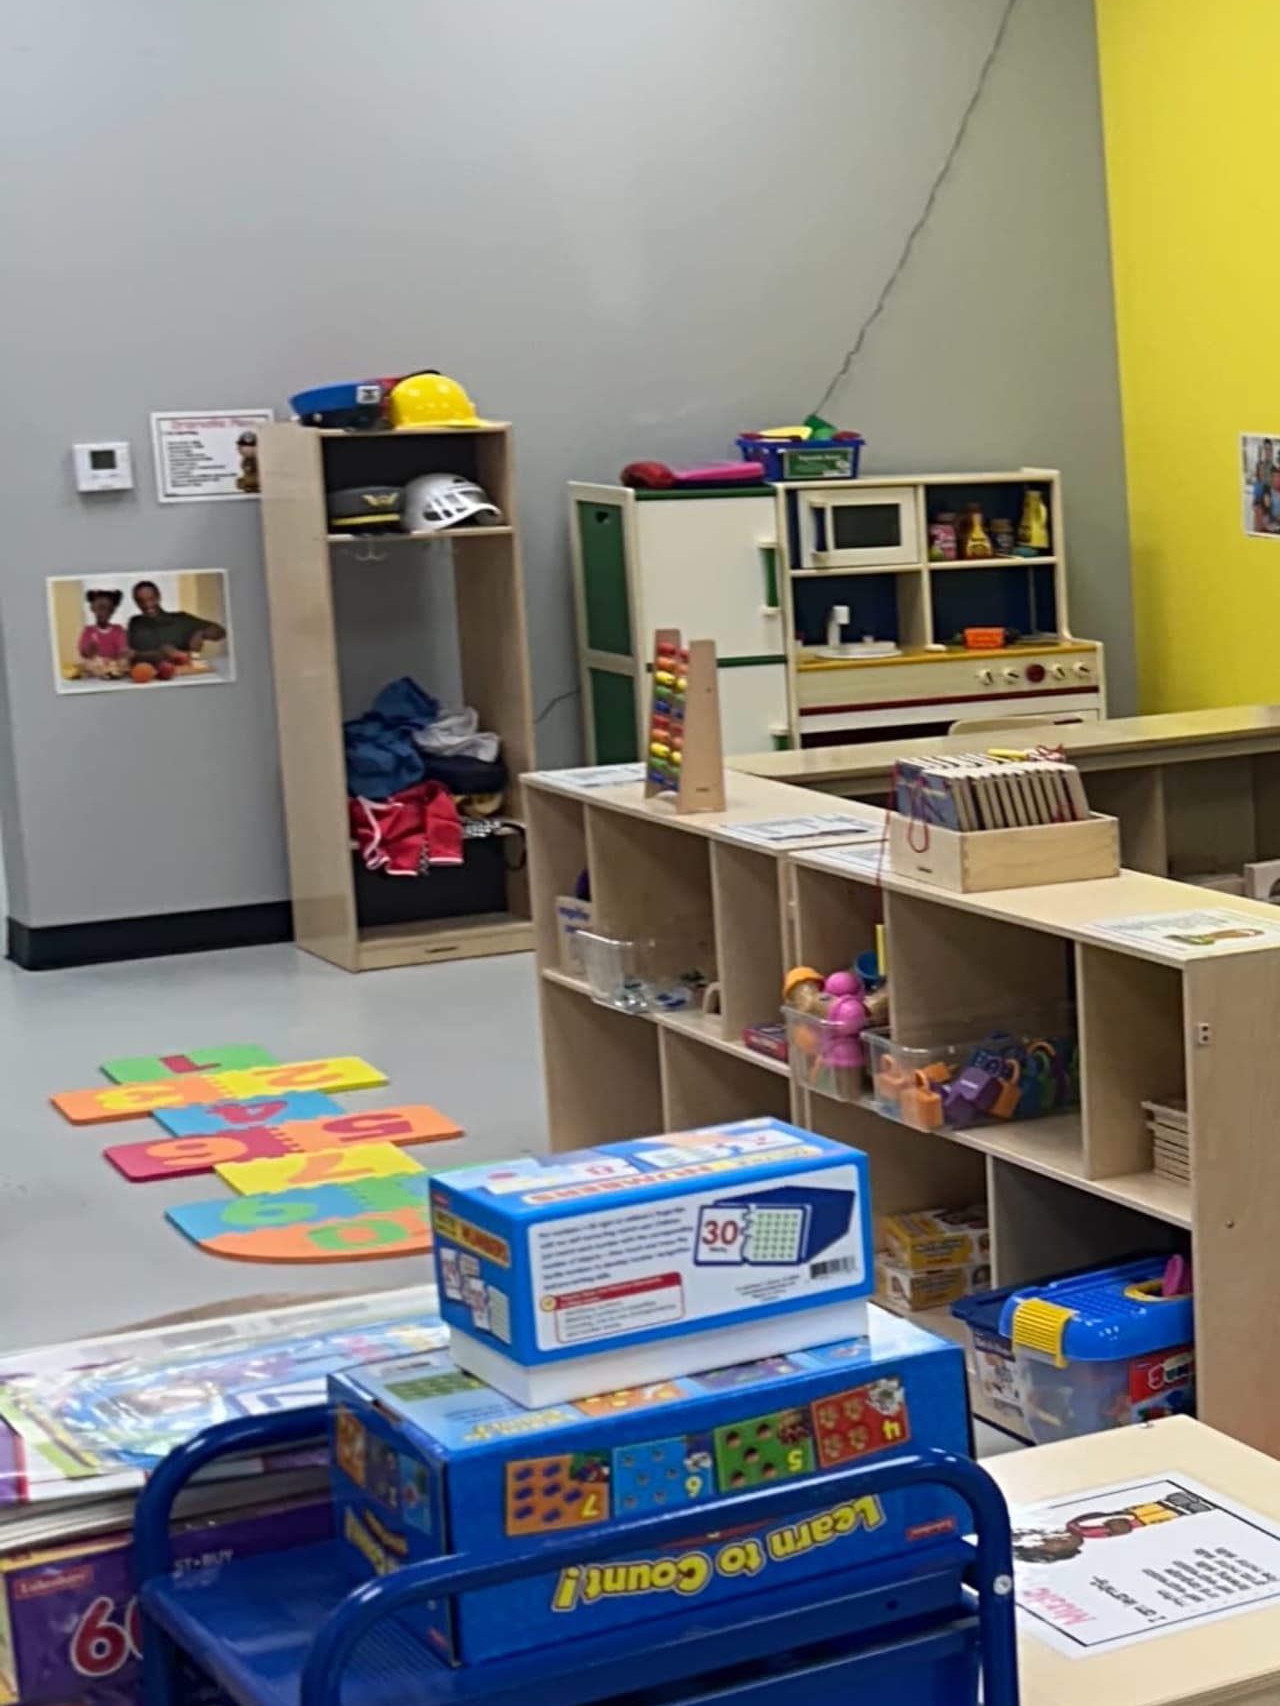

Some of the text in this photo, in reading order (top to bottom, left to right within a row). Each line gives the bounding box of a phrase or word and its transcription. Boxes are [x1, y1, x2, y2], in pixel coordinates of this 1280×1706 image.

[322, 1112, 414, 1142] 5
[702, 1219, 739, 1246] 30
[786, 1450, 804, 1472] 5
[552, 1493, 886, 1612] Learn to Count!
